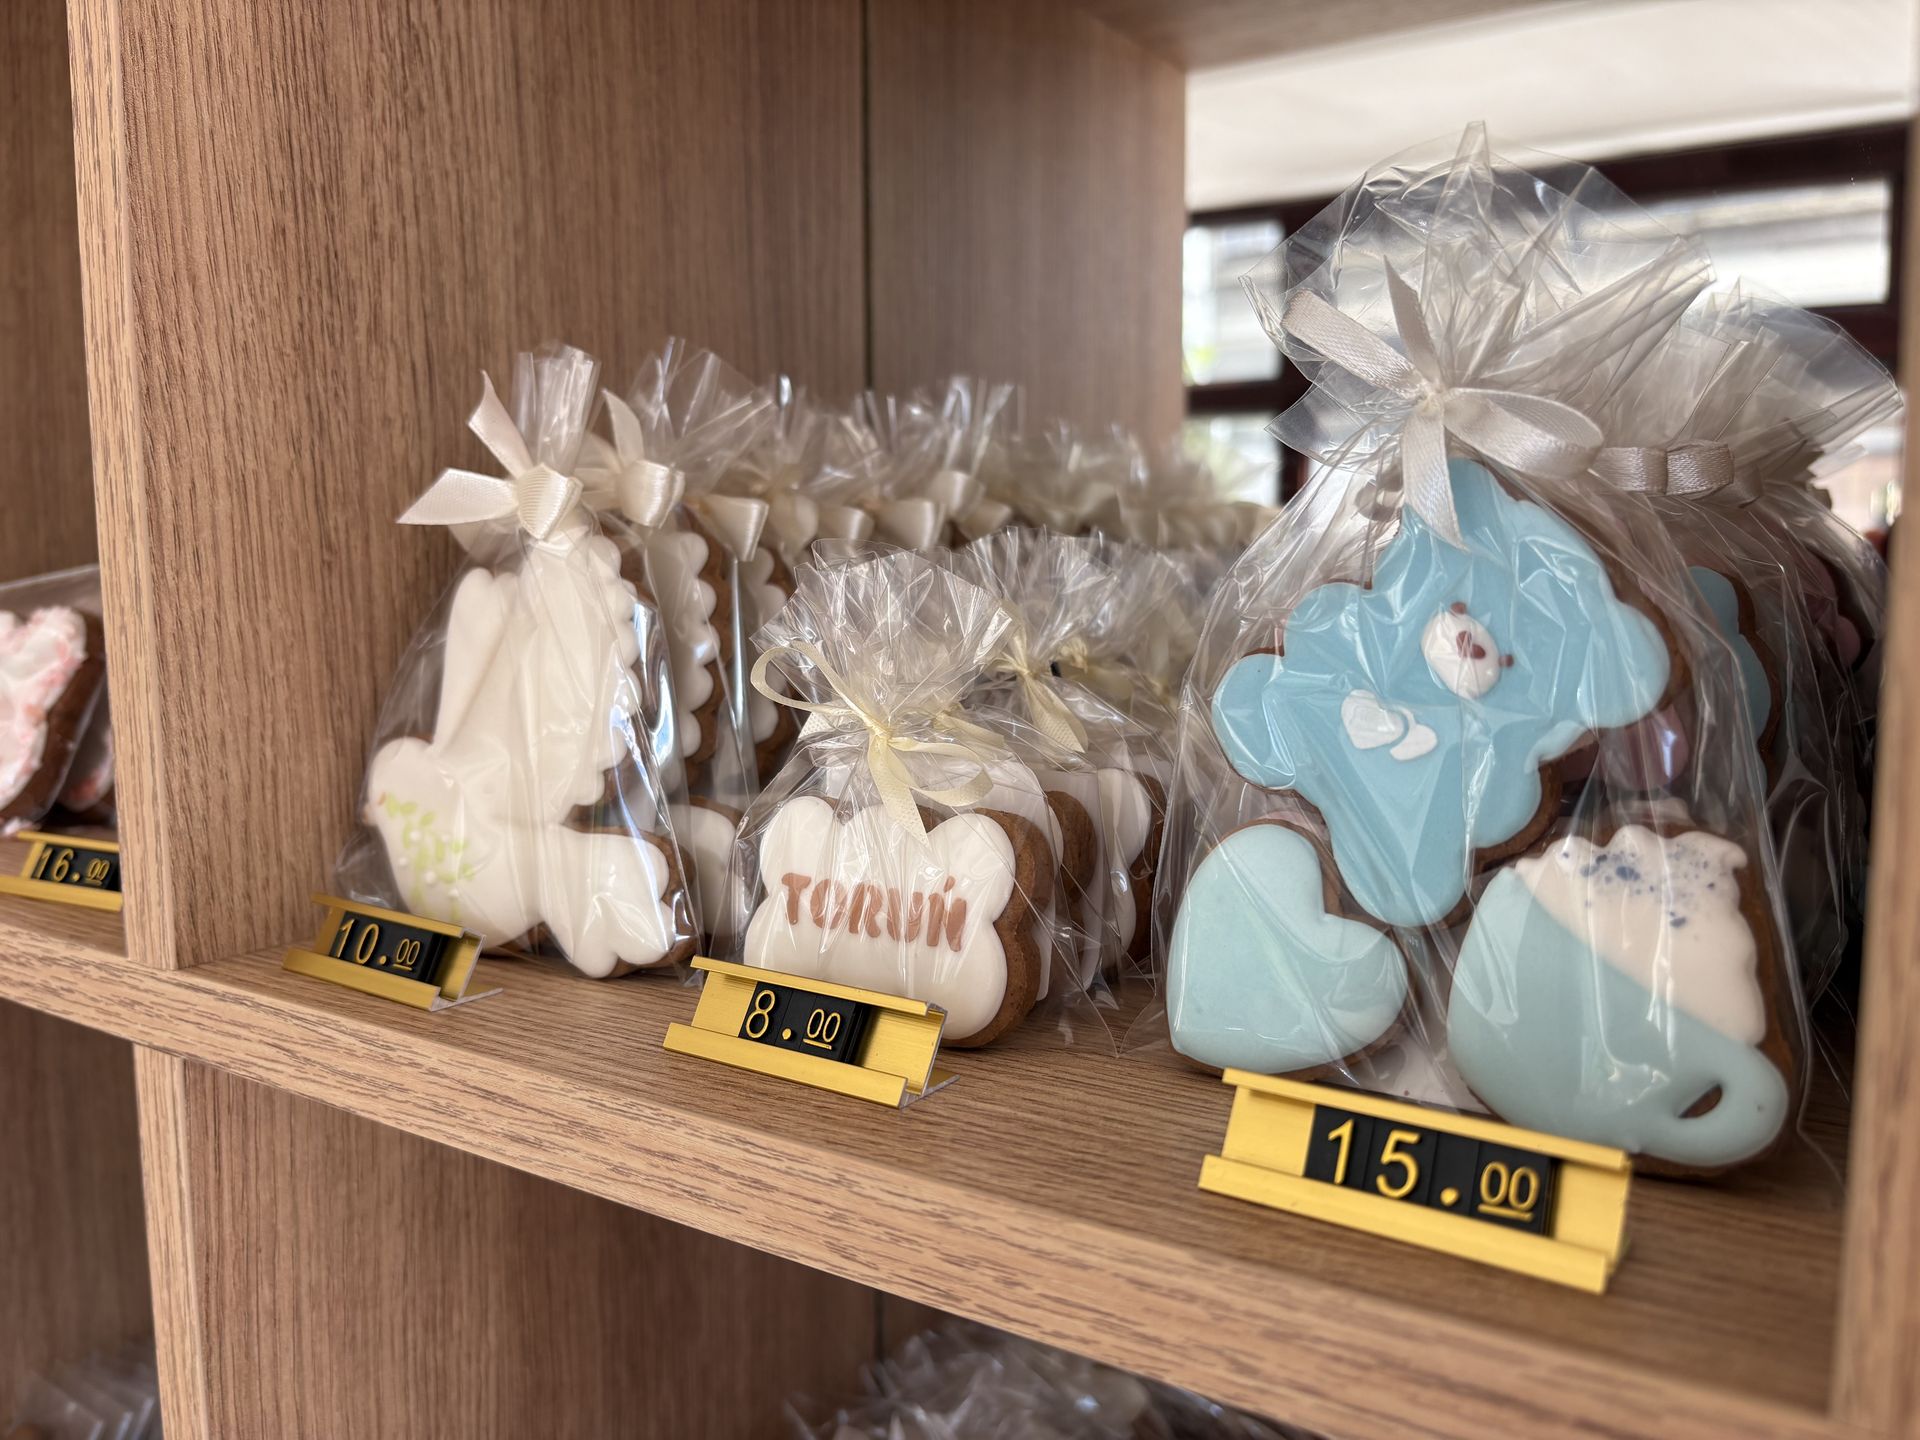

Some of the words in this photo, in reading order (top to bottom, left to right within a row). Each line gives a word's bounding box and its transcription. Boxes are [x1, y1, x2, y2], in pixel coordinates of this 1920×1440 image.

[38, 848, 110, 885] 16.00
[781, 872, 967, 952] TORUŃ
[339, 918, 421, 971] 10.00
[746, 989, 841, 1050] 8.00
[1327, 1118, 1541, 1222] 15.00
